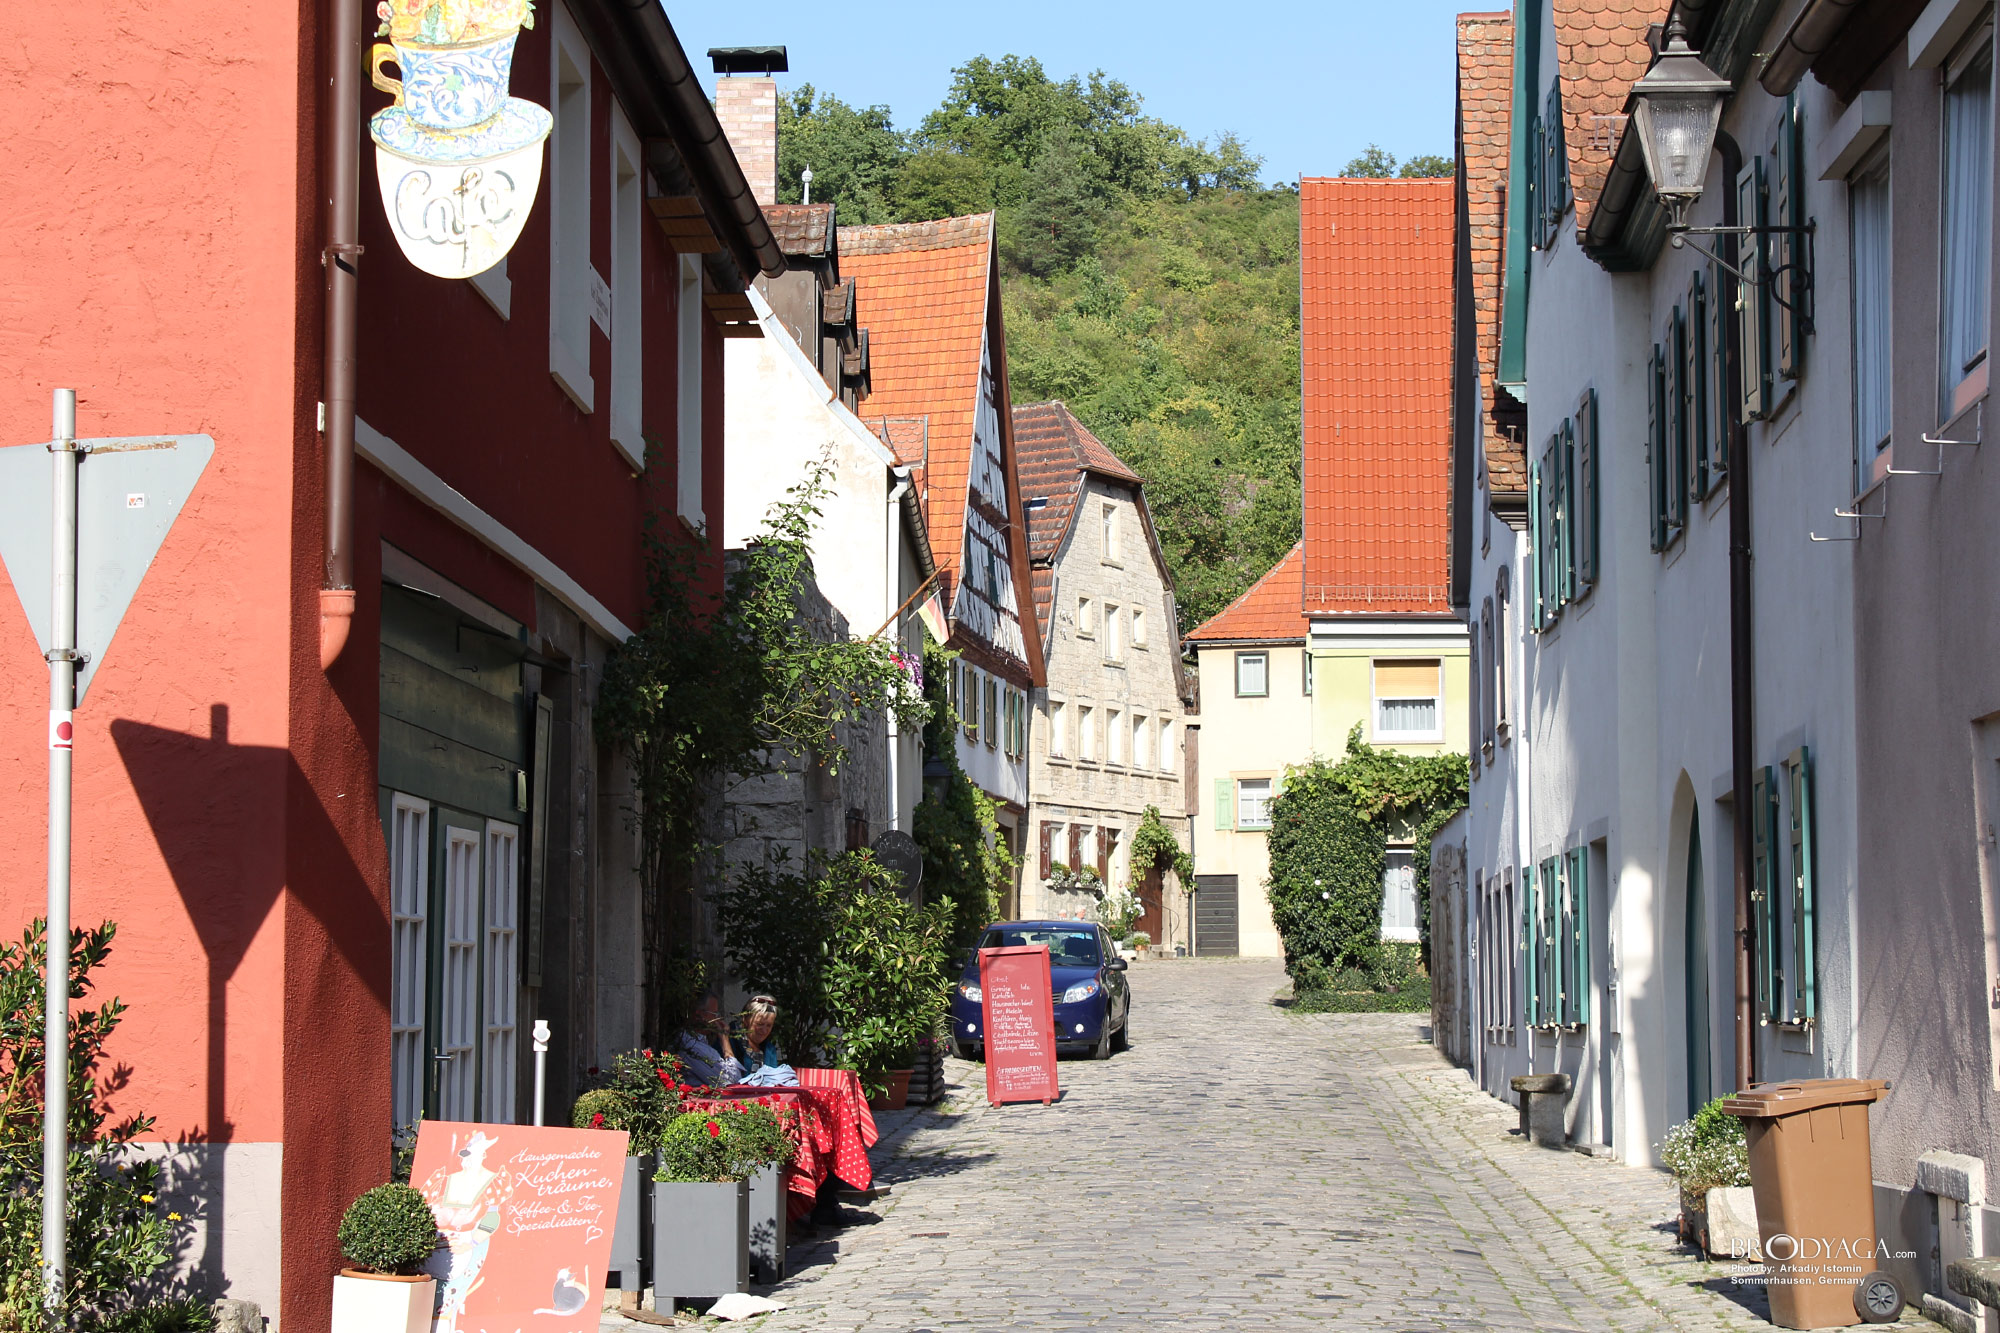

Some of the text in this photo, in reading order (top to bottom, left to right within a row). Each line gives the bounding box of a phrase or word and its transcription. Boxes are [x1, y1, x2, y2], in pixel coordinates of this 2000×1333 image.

[509, 1146, 601, 1166] Hausgemachte
[516, 1161, 597, 1187] Kuchen-
[537, 1177, 613, 1196] träume,
[508, 1200, 556, 1218] Kaffee-
[557, 1199, 573, 1214] &
